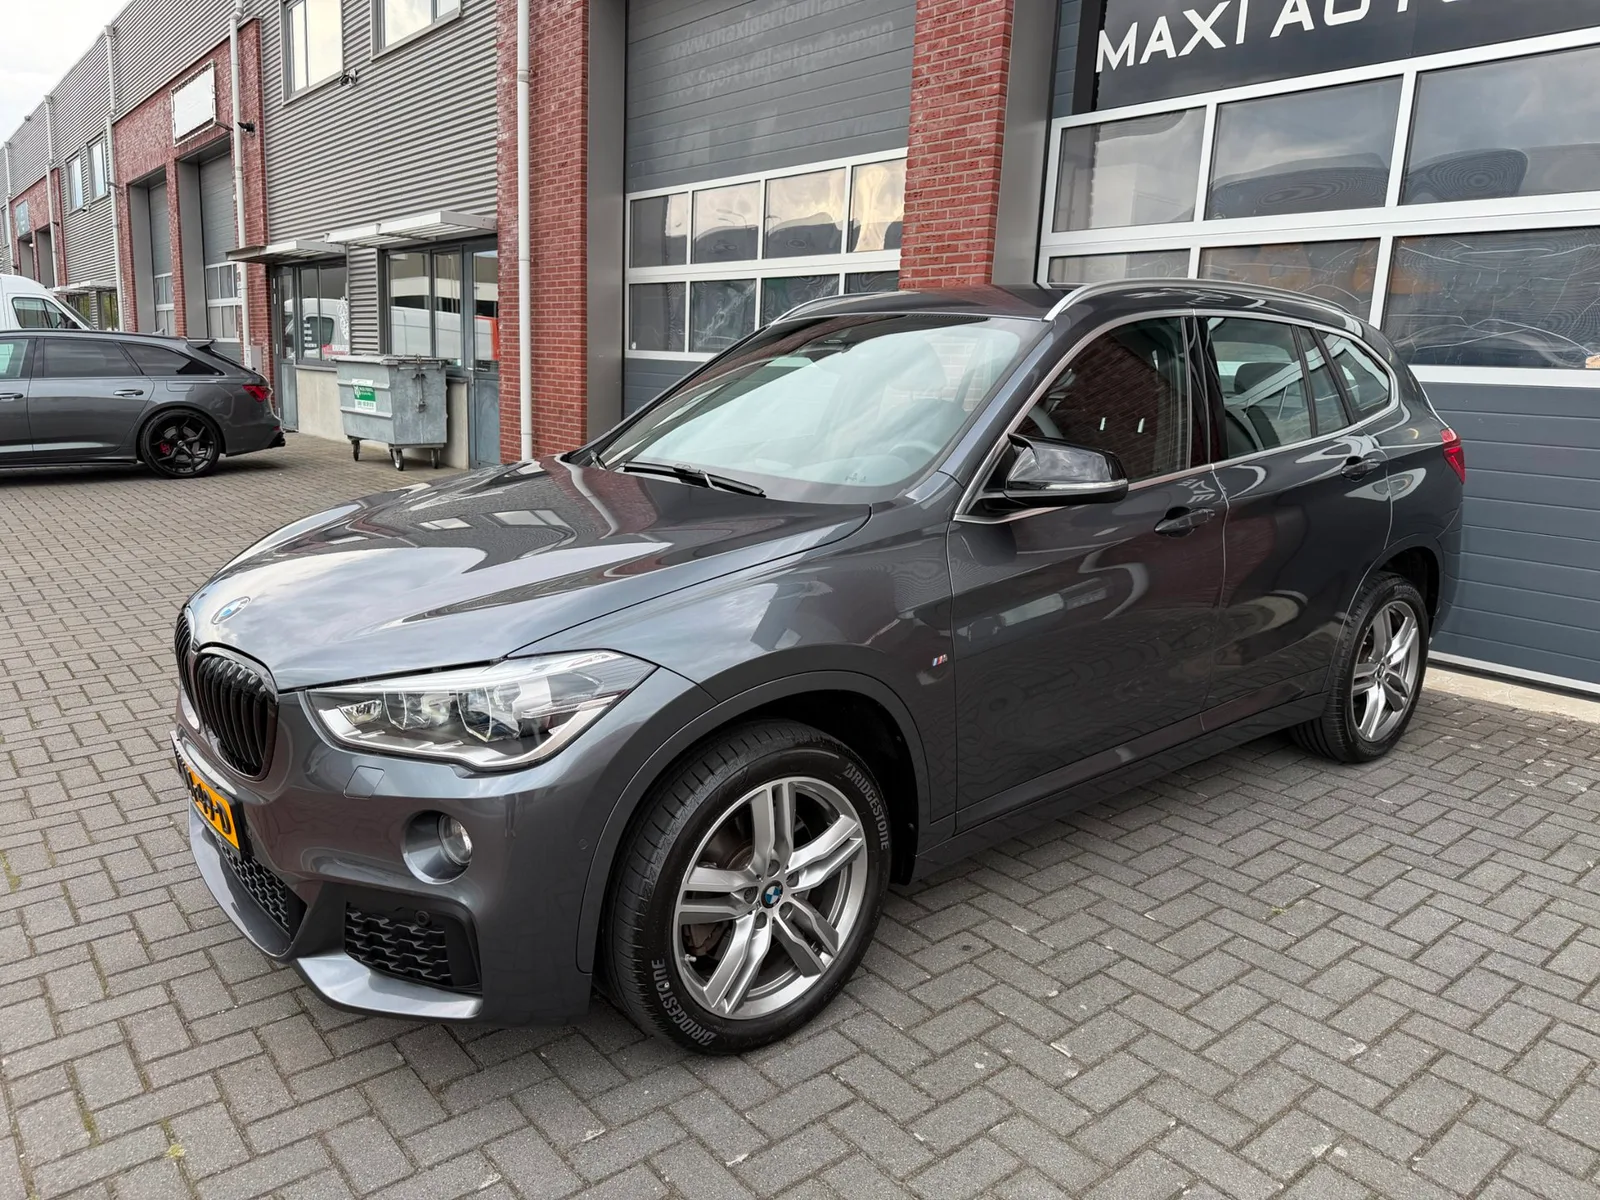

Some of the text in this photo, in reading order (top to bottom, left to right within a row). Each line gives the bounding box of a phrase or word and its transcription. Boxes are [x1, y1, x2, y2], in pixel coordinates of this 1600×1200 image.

[1095, 0, 1458, 73] MAXI AU
[842, 762, 890, 850] BRIDGESTONE
[651, 958, 717, 1046] BRIDGESTONE
